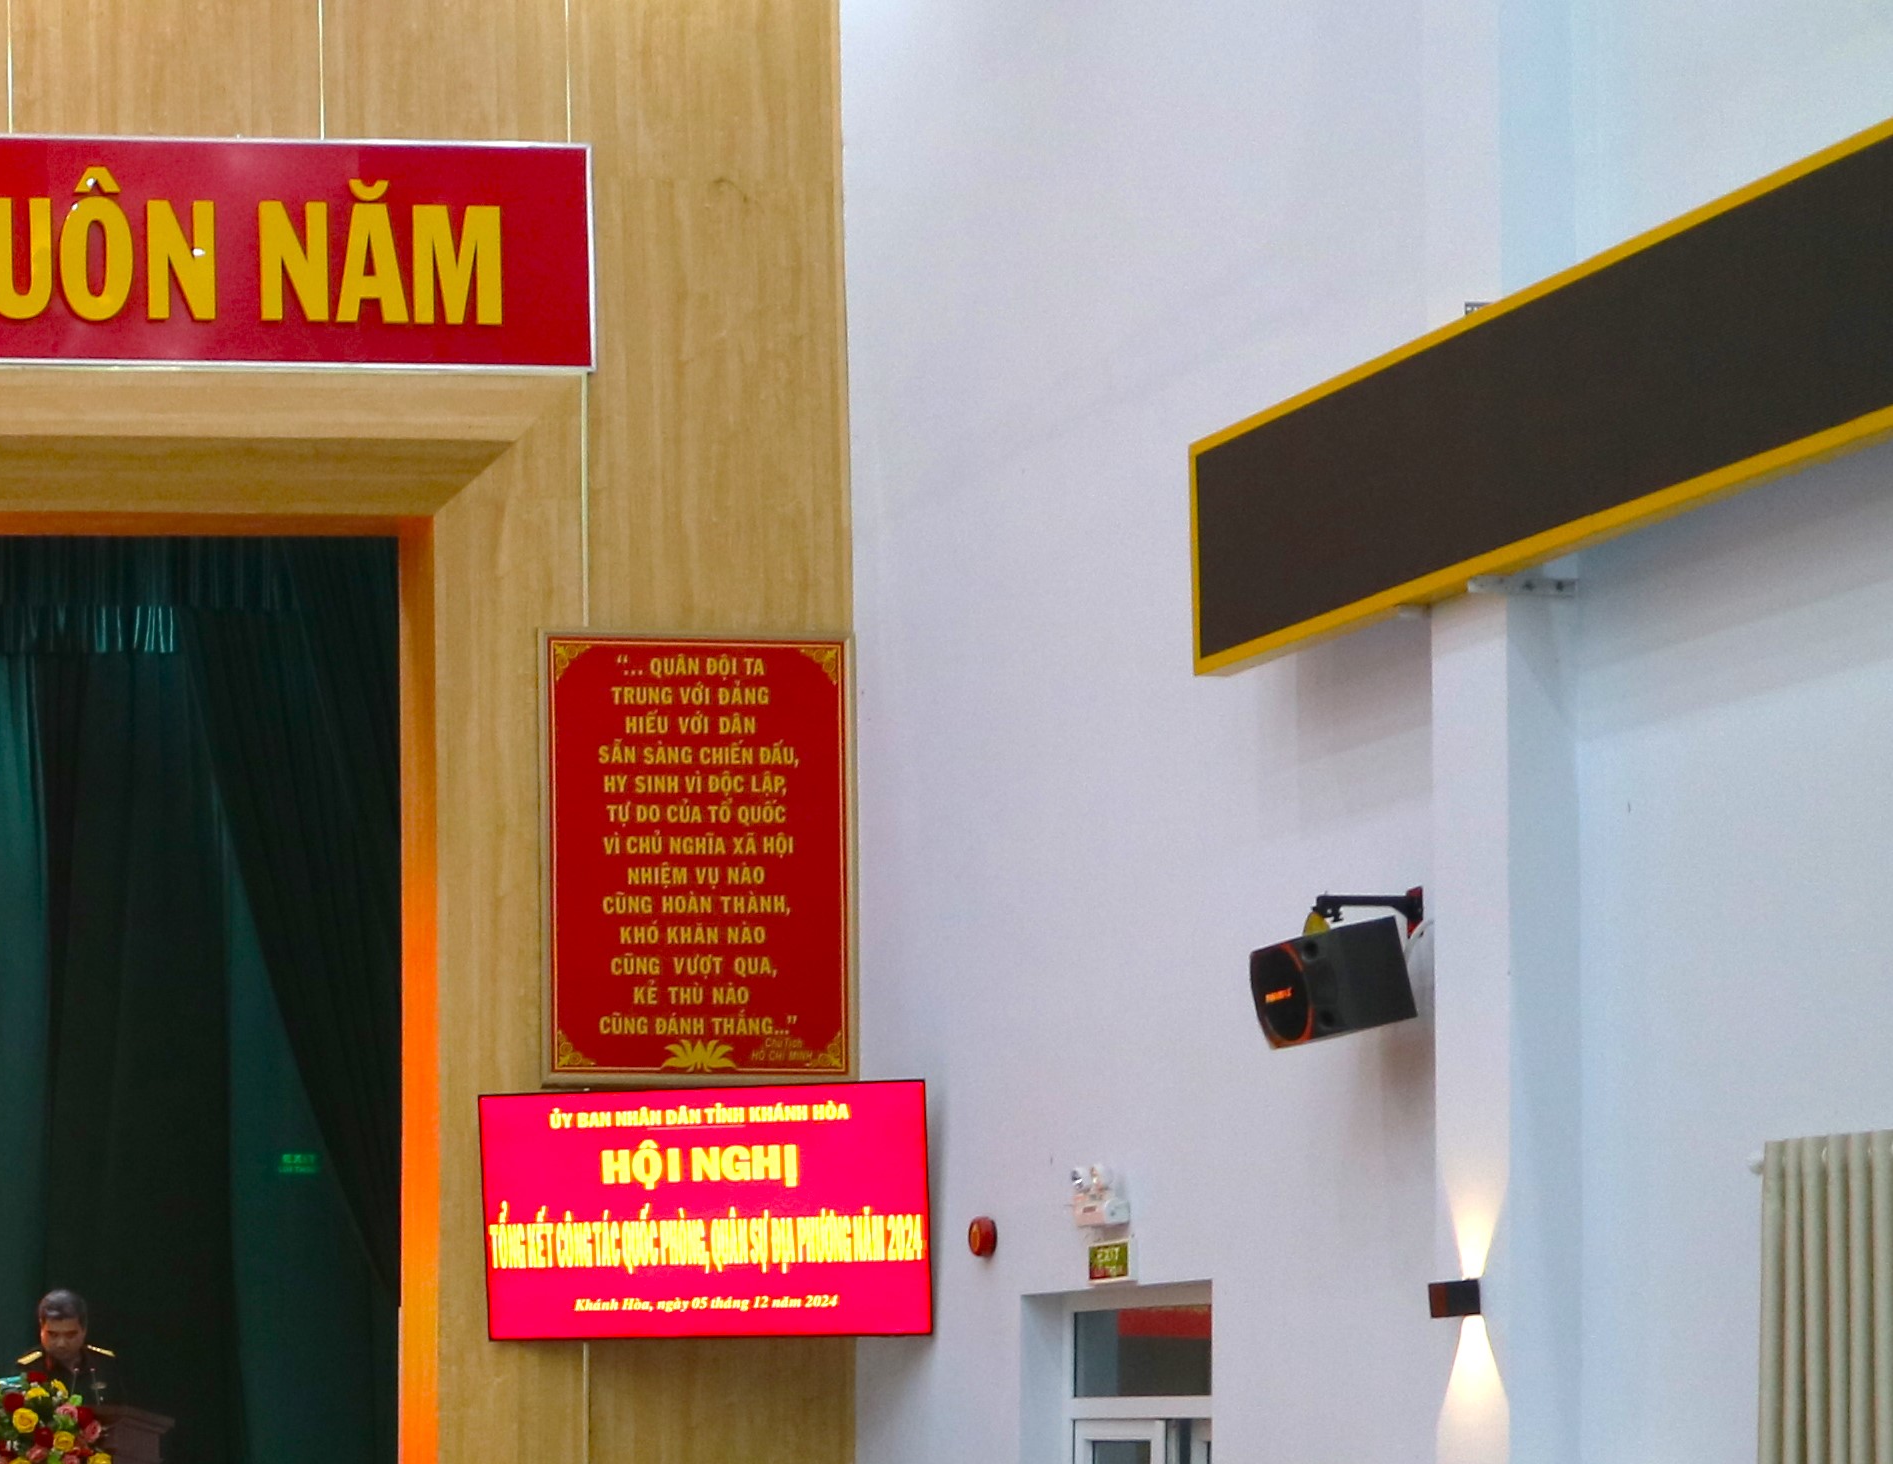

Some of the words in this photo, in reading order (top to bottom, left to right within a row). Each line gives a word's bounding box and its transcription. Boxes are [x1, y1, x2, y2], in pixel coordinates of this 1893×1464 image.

[259, 179, 502, 324] NĂM
[650, 654, 699, 678] QUÂN
[706, 654, 737, 680] ĐỘI
[743, 658, 764, 676] TA
[611, 687, 673, 705] TRUNG
[679, 681, 710, 705] VỚI
[718, 680, 769, 705] ĐẢNG
[626, 710, 668, 734] HIẾU
[678, 711, 709, 734] VỚI
[719, 712, 755, 734] DÂN
[599, 739, 636, 763] SẴN
[643, 741, 692, 764] SÀNG
[699, 740, 753, 765] CHIẾN
[604, 775, 627, 792] HY
[635, 775, 679, 793] SINH
[685, 771, 702, 793] VÌ
[708, 771, 744, 796] ĐỘC
[606, 801, 631, 826] TỰ
[636, 805, 660, 822] DO
[666, 798, 702, 823] CỦA
[707, 798, 732, 823] TỔ
[737, 800, 786, 826] QUỐC
[603, 832, 620, 854] VÌ
[626, 830, 662, 854] CHỦ
[669, 832, 726, 854] NGHĨA
[733, 833, 756, 854] XÃ
[763, 832, 793, 858] HỘI
[628, 862, 687, 888] NHIỆM
[695, 867, 719, 889] VỤ
[727, 862, 765, 884] NÀO
[603, 892, 652, 914] CŨNG
[662, 891, 712, 913] HOÀN
[620, 926, 659, 944] KHÓ
[667, 923, 718, 944] KHĂN
[727, 926, 765, 944] NÀO
[611, 953, 660, 975] CŨNG
[673, 954, 723, 979] VƯỢT
[634, 980, 657, 1005] KẺ
[668, 983, 703, 1004] THÙ
[712, 982, 749, 1004] NÀO
[599, 1012, 648, 1034] CŨNG
[655, 1013, 704, 1035] ĐÁNH
[550, 1108, 573, 1129] ỦY
[576, 1112, 613, 1128] BAN
[615, 1106, 662, 1127] NHÂN
[665, 1105, 701, 1125] DÂN
[704, 1103, 745, 1123] TỈNH
[748, 1102, 810, 1122] KHÁNH
[811, 1100, 850, 1120] HÒA
[601, 1139, 682, 1190] HỘI
[691, 1144, 798, 1187] NGHỊ
